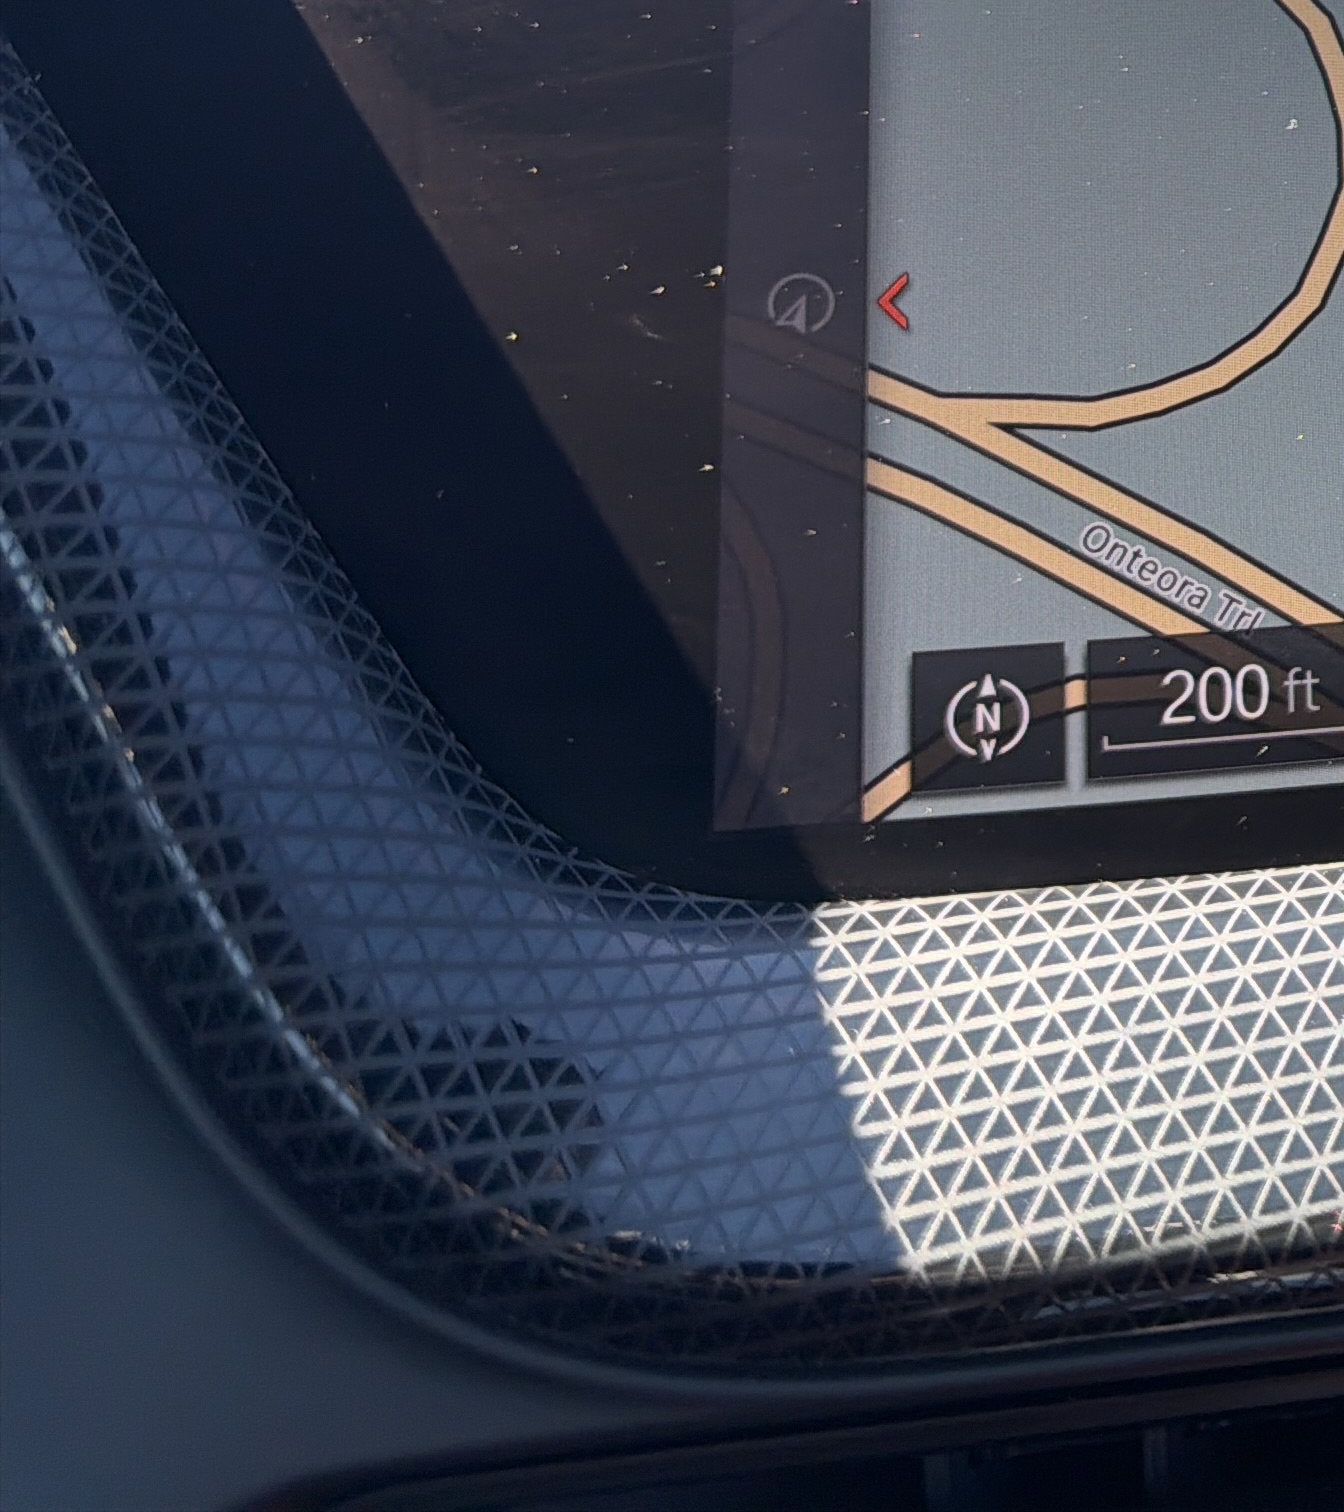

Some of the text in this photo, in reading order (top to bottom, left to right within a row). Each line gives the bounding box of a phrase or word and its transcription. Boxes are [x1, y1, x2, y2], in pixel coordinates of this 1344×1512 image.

[1082, 524, 1209, 609] Onteora
[975, 701, 1001, 734] N
[1160, 663, 1321, 727] 200 ft
